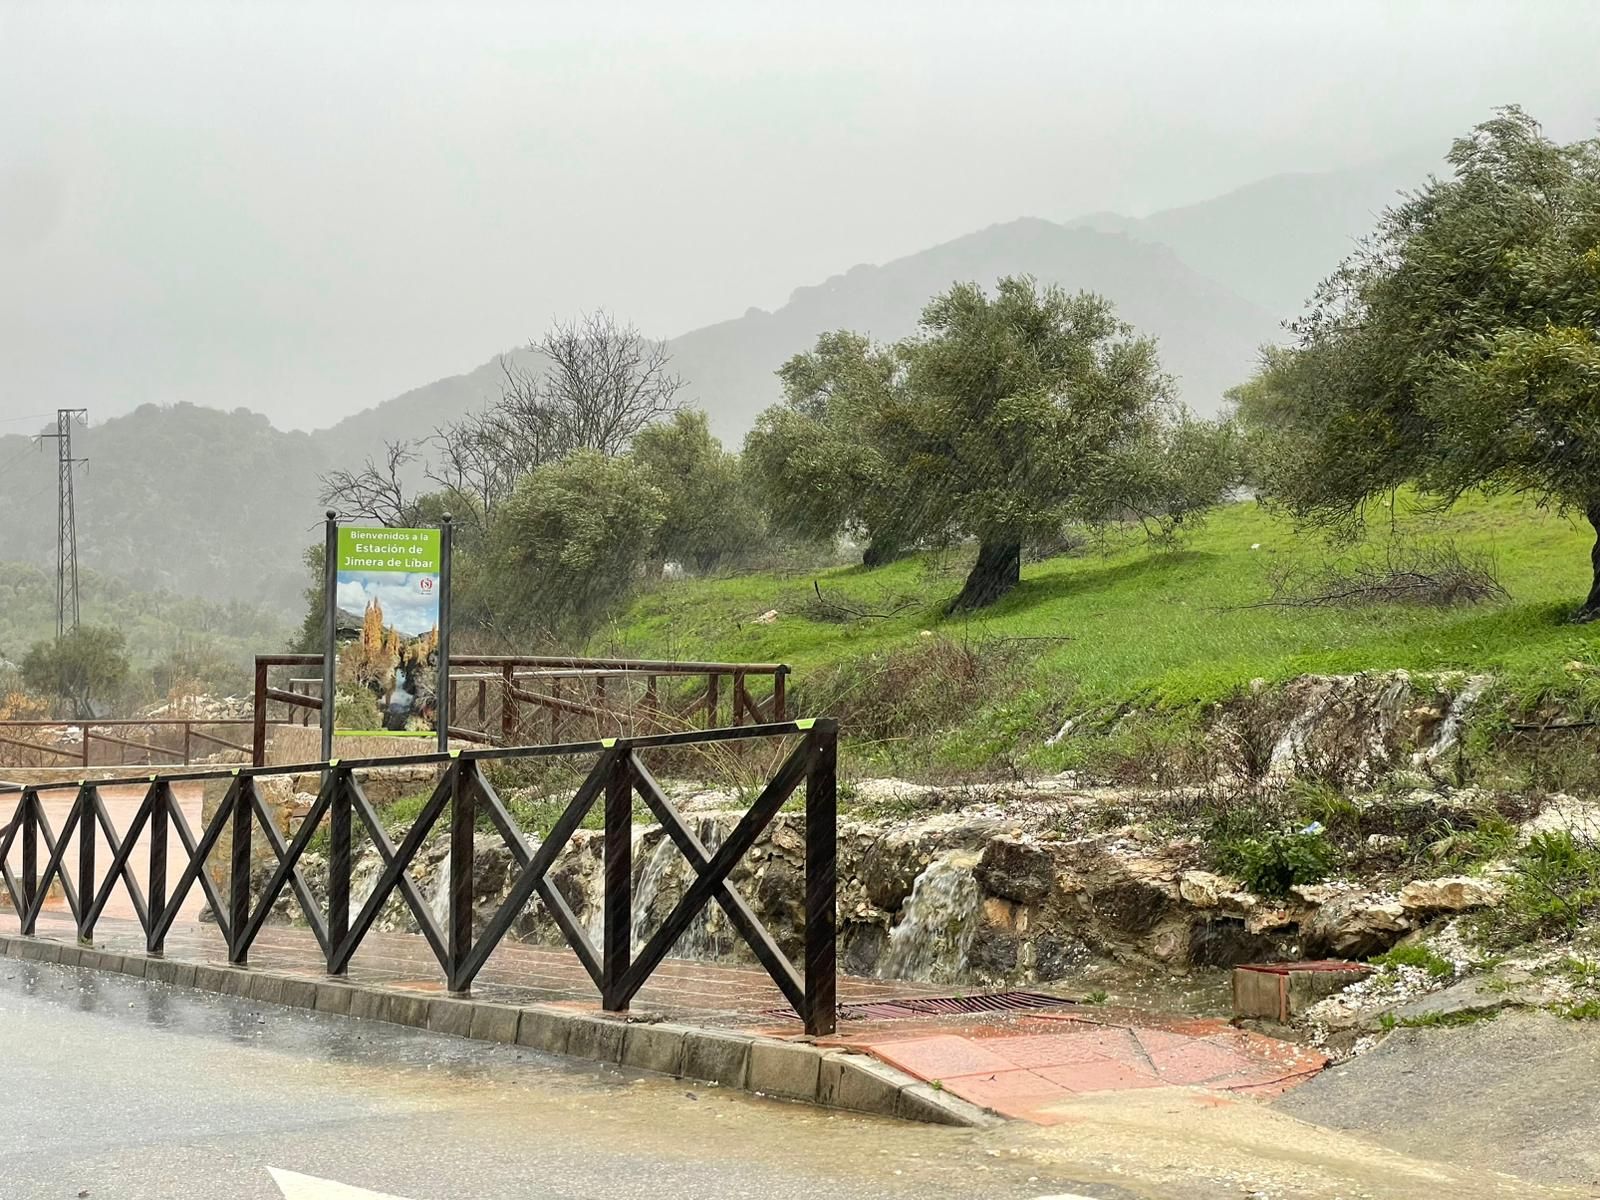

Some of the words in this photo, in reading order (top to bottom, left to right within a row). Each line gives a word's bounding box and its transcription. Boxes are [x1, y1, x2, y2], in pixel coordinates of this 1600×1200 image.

[350, 531, 410, 540] Bienvenidos
[420, 532, 429, 541] la
[355, 543, 405, 553] Estación
[408, 544, 423, 554] de
[344, 556, 384, 566] Jimera
[387, 557, 402, 567] de
[405, 558, 433, 568] Líbar
